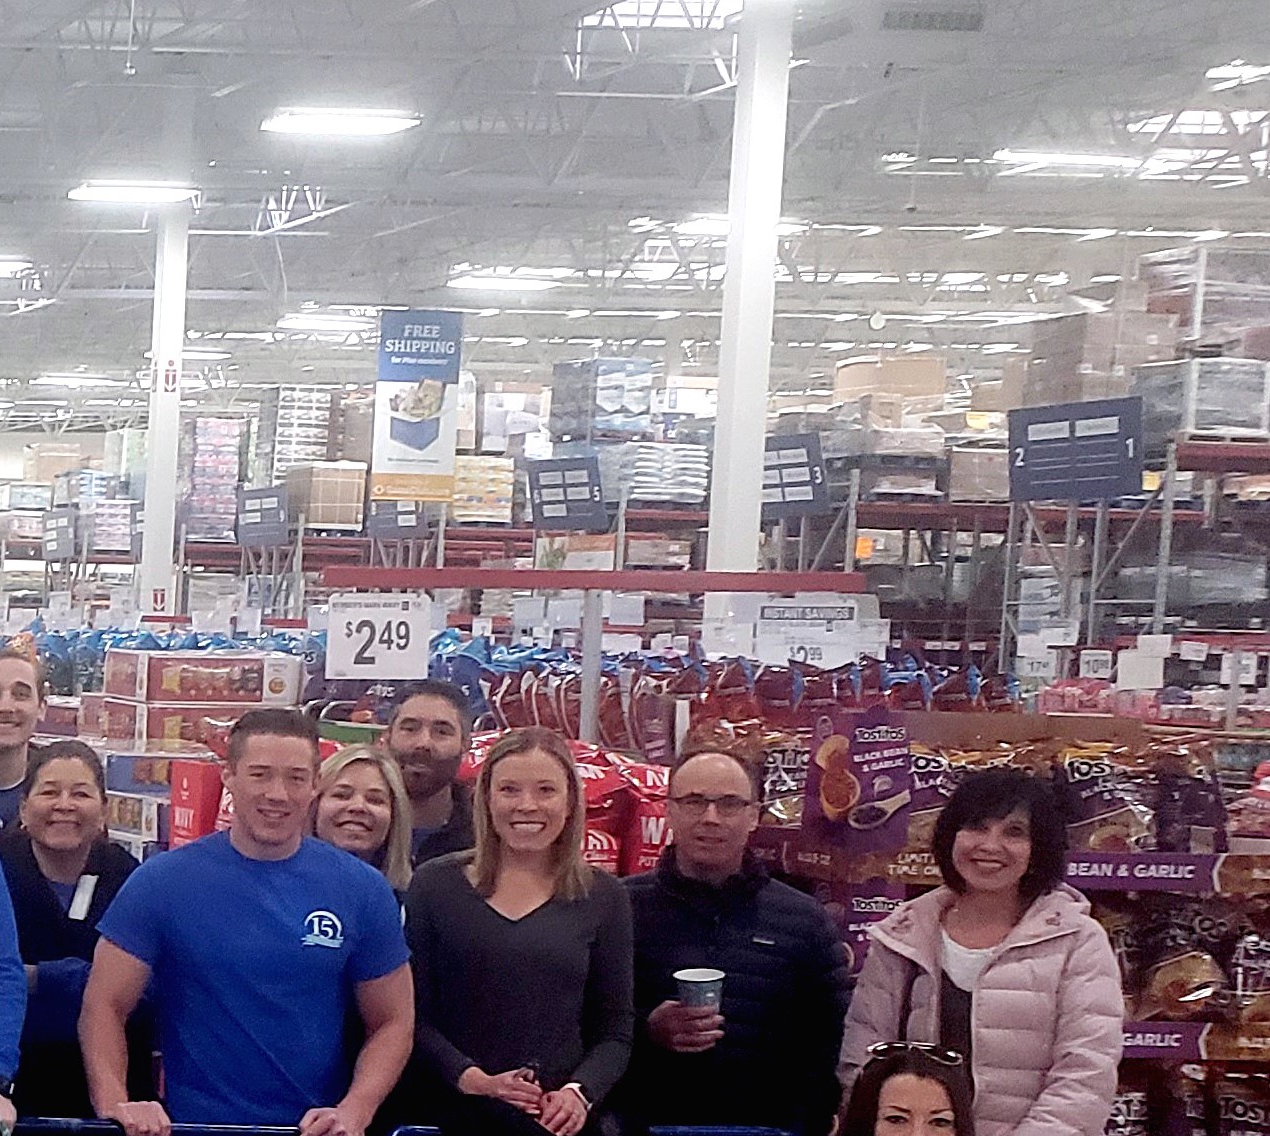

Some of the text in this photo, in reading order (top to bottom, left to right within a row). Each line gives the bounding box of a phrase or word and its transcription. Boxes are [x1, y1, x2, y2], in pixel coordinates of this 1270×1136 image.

[404, 325, 441, 338] FREE
[385, 340, 456, 355] SHIPPING
[1125, 437, 1134, 459] 1
[1014, 447, 1026, 467] 2
[812, 465, 823, 484] 3
[853, 751, 881, 763] BLACK
[871, 760, 905, 771] GARLIC
[888, 864, 919, 876] TIME
[1066, 863, 1196, 879] BEAN & GARLIC
[312, 917, 334, 939] 15
[1123, 1033, 1183, 1047] GARLIC
